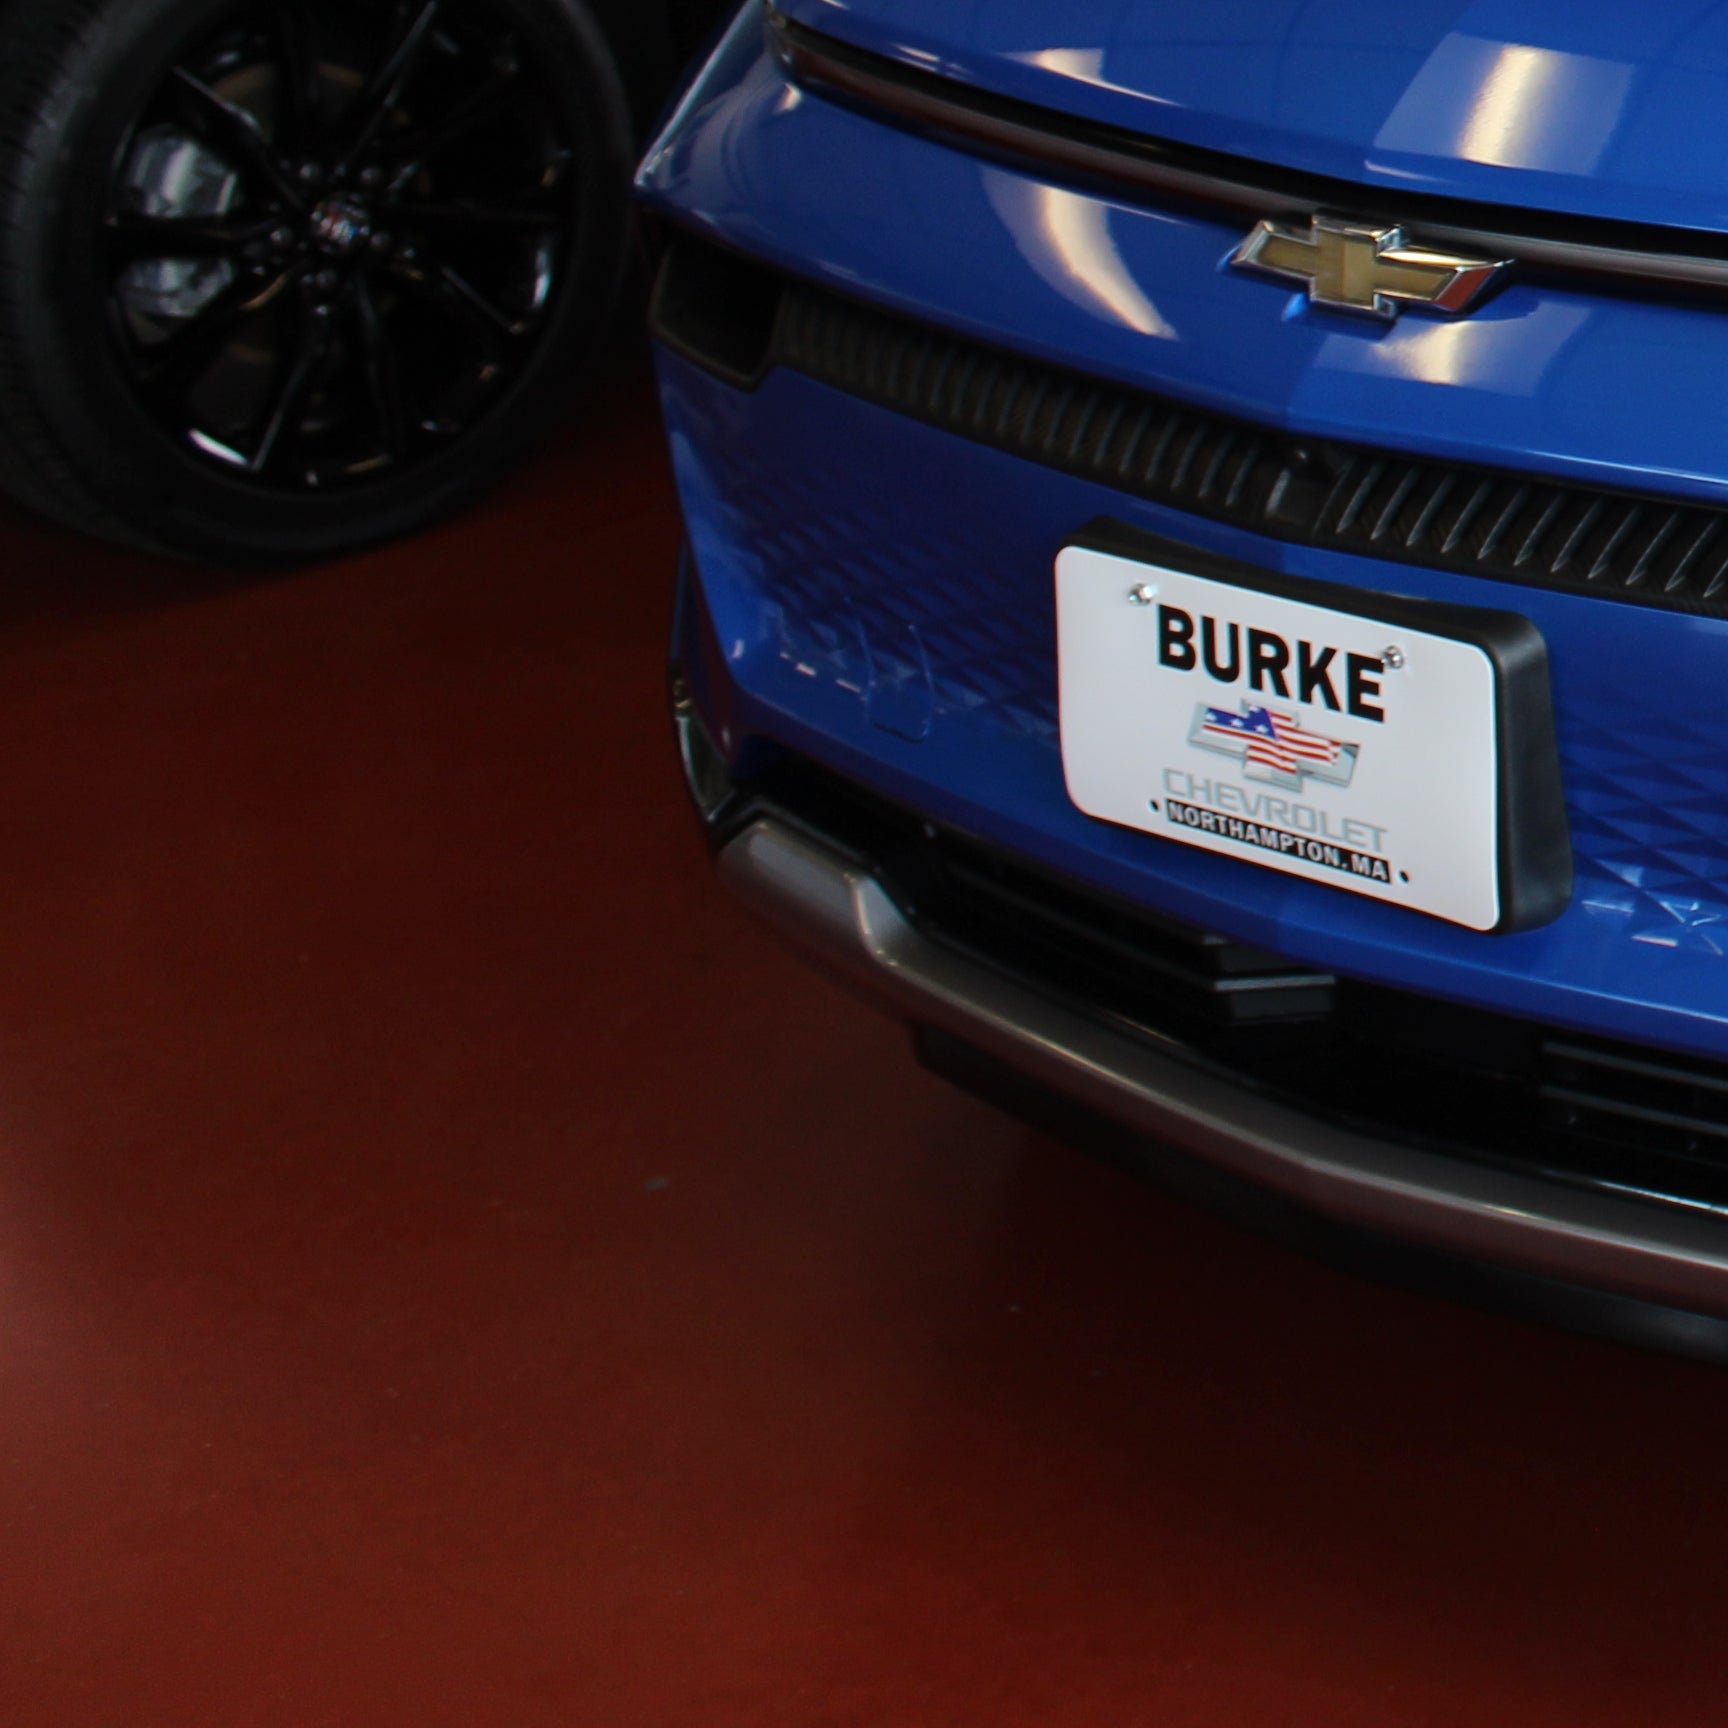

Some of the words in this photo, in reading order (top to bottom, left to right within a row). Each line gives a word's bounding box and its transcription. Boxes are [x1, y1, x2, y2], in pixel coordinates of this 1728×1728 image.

[1158, 603, 1385, 724] BURKE
[1163, 768, 1389, 853] CHEVROLET
[1351, 853, 1388, 881] MA
